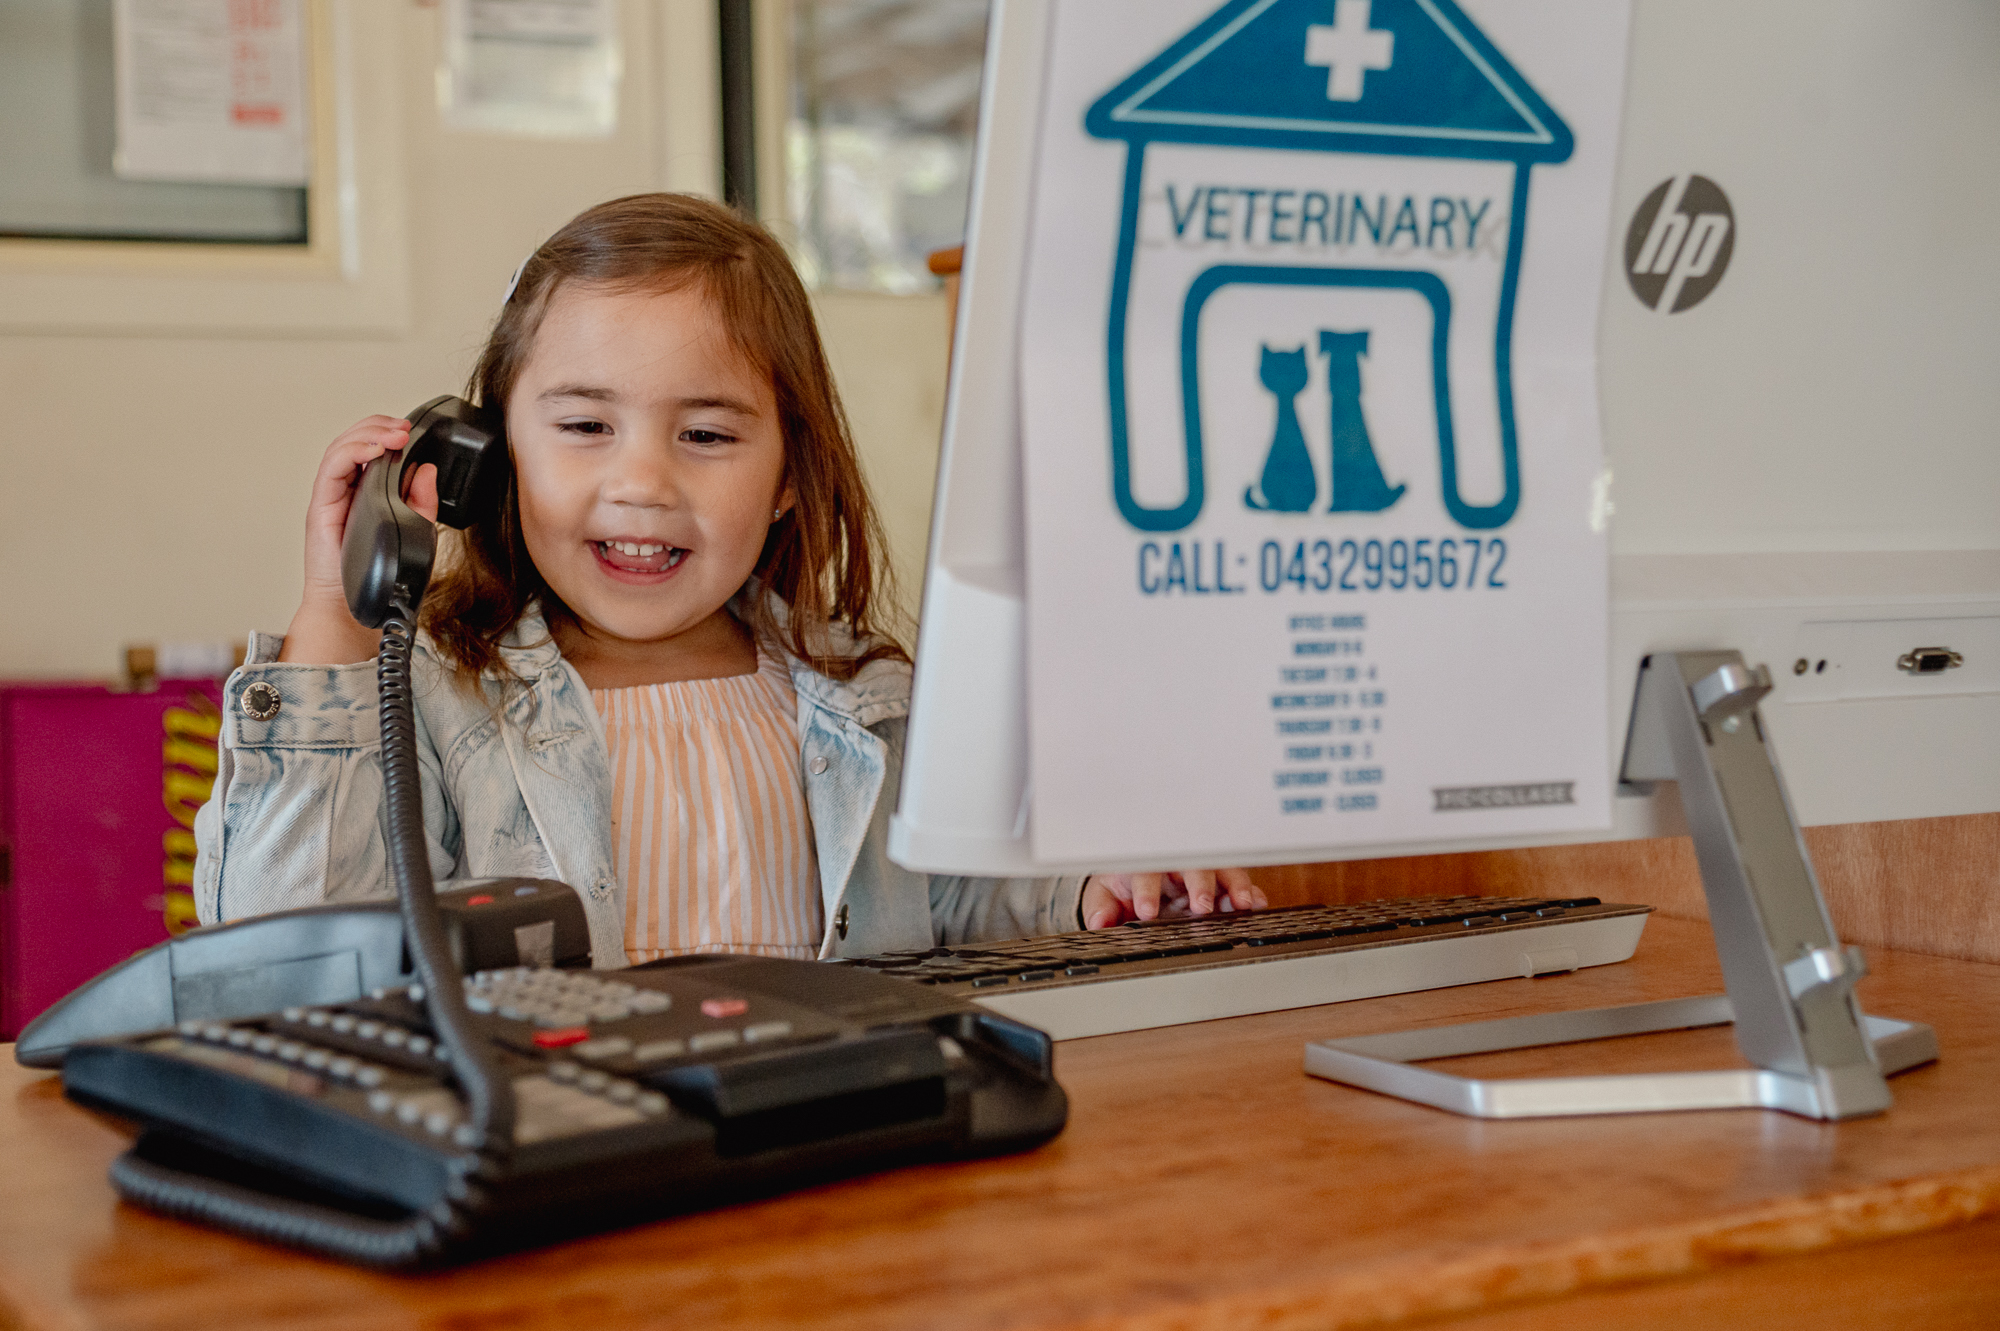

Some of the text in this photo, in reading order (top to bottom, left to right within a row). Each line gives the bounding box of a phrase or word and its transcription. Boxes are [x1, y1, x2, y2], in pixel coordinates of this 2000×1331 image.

[1166, 184, 1491, 249] VETERINARY
[1632, 174, 1730, 314] hp
[1138, 538, 1507, 594] CALL: 0432995672
